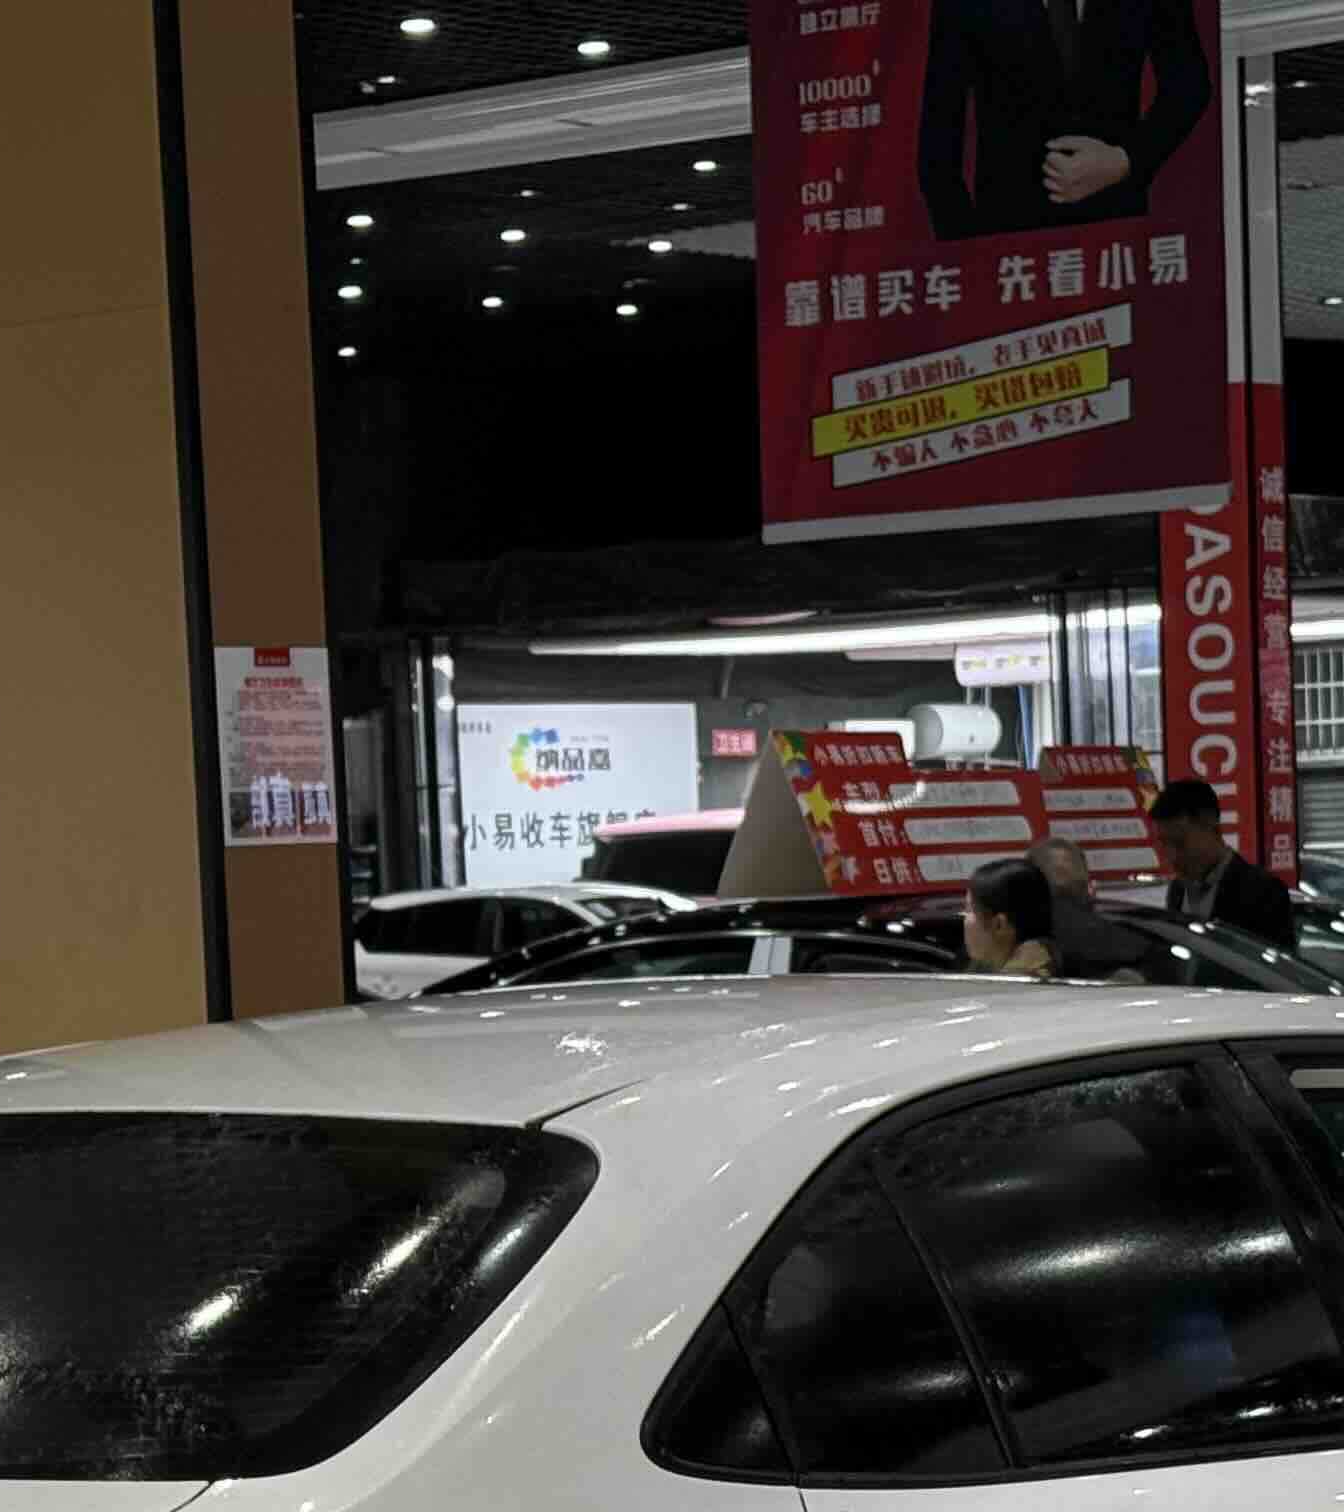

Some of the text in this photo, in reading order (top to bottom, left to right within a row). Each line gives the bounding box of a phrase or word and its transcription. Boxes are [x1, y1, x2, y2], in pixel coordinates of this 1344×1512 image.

[783, 233, 1189, 328] 靠谱买车 先看小易
